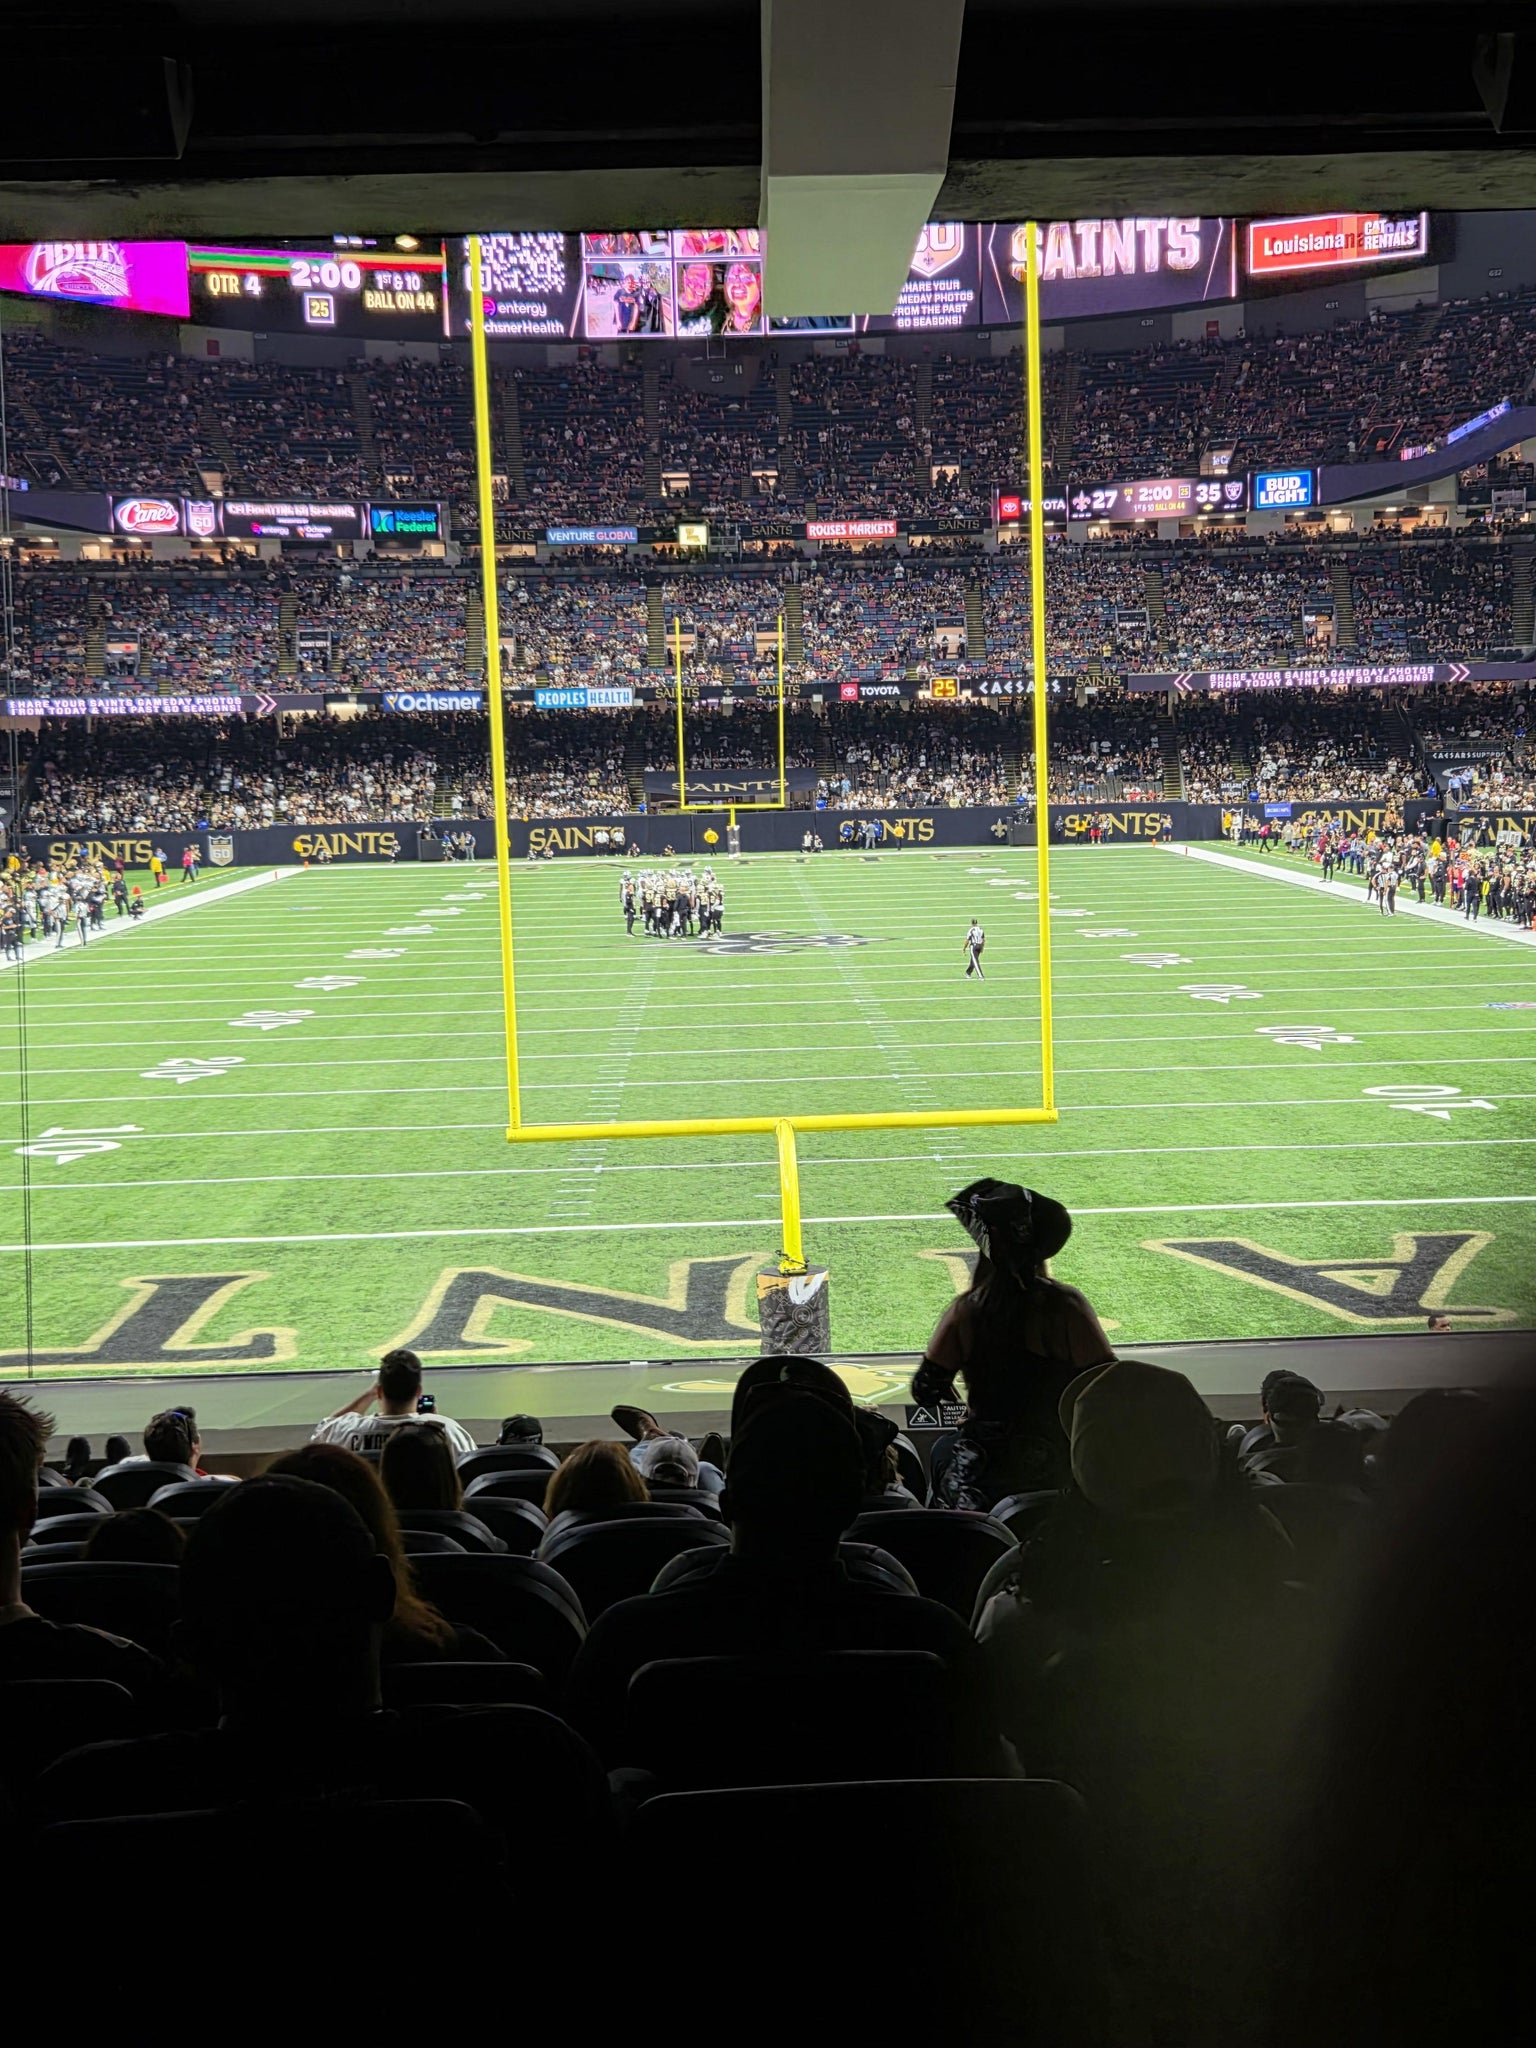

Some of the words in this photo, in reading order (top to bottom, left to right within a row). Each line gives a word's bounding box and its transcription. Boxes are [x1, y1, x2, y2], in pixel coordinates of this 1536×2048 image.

[1363, 219, 1388, 236] CAT
[1263, 232, 1346, 257] Louisiana
[1363, 230, 1417, 250] RENTALS
[1011, 217, 1201, 283] SAINTS
[291, 261, 361, 289] 2:00
[376, 273, 392, 290] 1ST
[393, 277, 402, 290] &
[405, 273, 421, 291] 10
[208, 274, 240, 294] QTR
[245, 274, 261, 295] 4
[933, 279, 960, 292] YOUR
[365, 291, 396, 309] BALL
[397, 292, 415, 309] ON
[417, 292, 435, 310] 44
[899, 292, 932, 305] MEDAY
[934, 290, 974, 303] PHOTOS
[310, 302, 329, 318] 25
[499, 303, 547, 317] entergy
[921, 304, 941, 316] THE
[942, 303, 968, 315] PAST
[913, 314, 962, 327] SEASONS!
[1179, 488, 1190, 497] 25
[1266, 477, 1302, 492] BUD
[1093, 489, 1118, 510] 27
[1138, 485, 1173, 502] 2:00
[1195, 485, 1222, 503] 35
[1259, 488, 1308, 504] LIGHT
[1021, 500, 1067, 512] TOTA
[122, 501, 175, 528] Cane's
[193, 517, 212, 528] 60
[395, 510, 438, 522] Keesler
[395, 521, 437, 533] Federal
[751, 525, 793, 537] SAINTS
[809, 523, 847, 537] ROUSES
[849, 522, 895, 536] MARKETS
[938, 519, 980, 531] SAINTS
[494, 529, 535, 541] SAINTS
[549, 531, 596, 542] VENTURE
[596, 530, 637, 541] GLOBAL
[1076, 675, 1121, 688] SAINTS
[1209, 672, 1247, 682] SHARE
[1251, 671, 1281, 681] YOUR
[1284, 670, 1327, 680] SAINTS
[1330, 668, 1385, 678] GAMEDAY
[1388, 665, 1435, 676] PHOTOS
[1210, 680, 1242, 689] FROM
[1246, 679, 1282, 688] TODAY
[1285, 678, 1293, 687] &
[1296, 677, 1320, 686] THE
[1323, 676, 1353, 686] PAST
[1375, 673, 1434, 683] SEASONS!
[860, 685, 900, 696] TOYOTA
[934, 680, 956, 697] 25
[53, 699, 86, 708] YOUR
[88, 698, 133, 707] SAINTS
[135, 697, 192, 707] GAMEDAY
[195, 696, 242, 706] PHOTOS
[398, 693, 481, 711] Ochsner
[538, 691, 586, 706] PEOPLES
[589, 690, 630, 705] HEALTH
[48, 707, 88, 715] TODAY
[90, 707, 100, 715] &
[102, 706, 127, 714] THE
[128, 706, 160, 714] PAST
[182, 704, 242, 713] SEASONS!
[1432, 752, 1472, 760] CAESARS
[671, 778, 790, 793] SAINTS
[839, 818, 935, 843] SNTS
[1064, 813, 1162, 838] SNTS
[297, 831, 399, 858] SAINTS
[213, 848, 231, 859] 60
[1361, 1085, 1499, 1115] 10
[14, 1124, 145, 1157] 10
